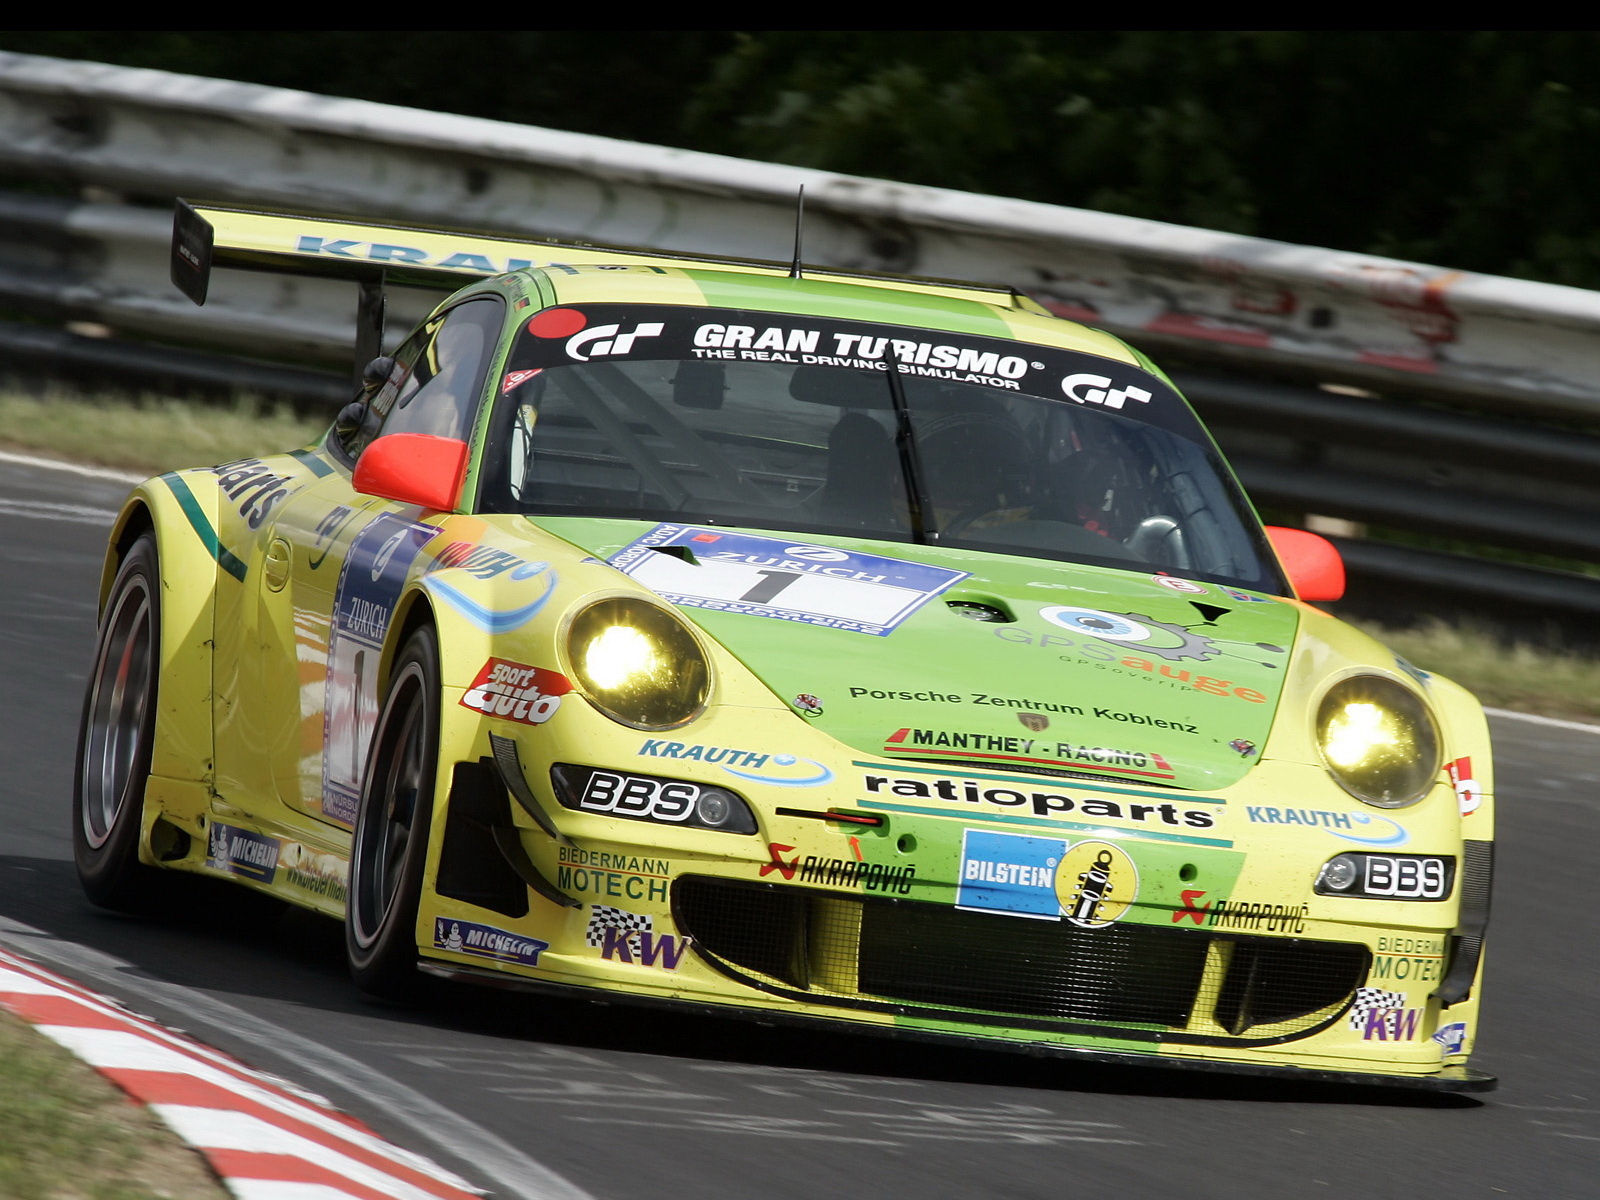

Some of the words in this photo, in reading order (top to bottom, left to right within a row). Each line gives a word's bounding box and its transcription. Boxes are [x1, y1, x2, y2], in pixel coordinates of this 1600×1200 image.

[693, 323, 821, 353] GRAN
[690, 349, 737, 360] THE
[741, 350, 799, 364] REAL
[801, 354, 890, 372] DRIVING
[897, 363, 1022, 392] SIMULATOR
[642, 524, 681, 545] ADAC
[710, 550, 888, 584] ZURICH
[737, 569, 804, 605] 1
[347, 596, 388, 640] ZURICH
[487, 663, 536, 687] sport
[993, 626, 1268, 704] GPSauge
[350, 649, 366, 785] 1
[463, 682, 561, 724] auto
[849, 686, 962, 704] Porsche
[970, 693, 1084, 715] Zentrum
[1092, 706, 1200, 735] Koblenz
[637, 739, 770, 769] KRAUTH
[912, 728, 1036, 754] MANTHEY
[1056, 742, 1148, 768] RACING
[580, 770, 701, 822] BBS
[864, 774, 1216, 829] ratioparts
[1246, 805, 1353, 830] KRAUTH
[229, 836, 278, 869] MICHELIN
[558, 845, 670, 876] BIEDERMANN
[557, 865, 668, 903] MOTECH
[1363, 855, 1446, 898] BBS
[465, 929, 540, 956] MICHELIN
[601, 926, 689, 971] KW
[1363, 1007, 1424, 1042] KW
